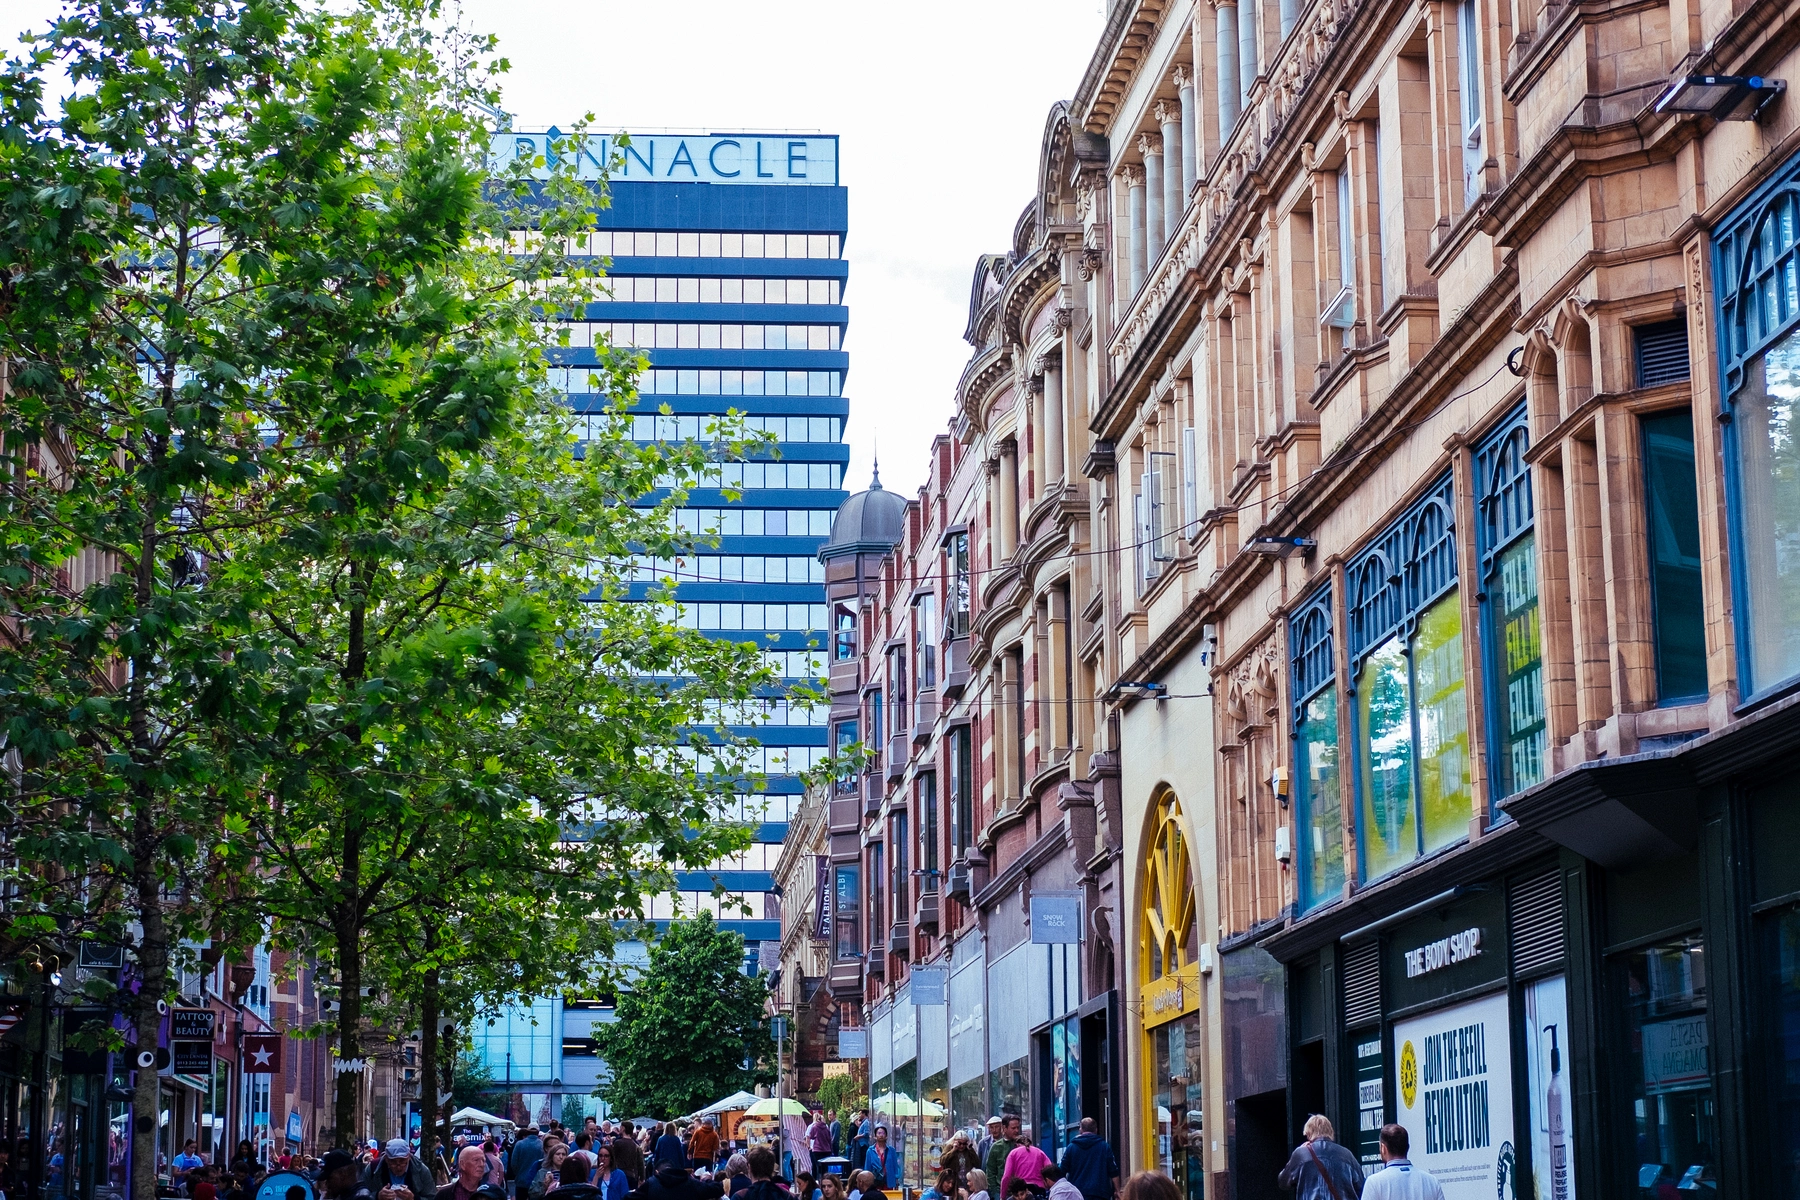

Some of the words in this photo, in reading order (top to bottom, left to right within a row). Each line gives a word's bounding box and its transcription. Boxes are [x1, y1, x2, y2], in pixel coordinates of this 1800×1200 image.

[515, 136, 807, 178] PINNACLE
[1404, 947, 1426, 978] THE
[1425, 937, 1451, 972] BODY
[175, 1012, 214, 1021] TATTOO
[175, 1027, 211, 1036] BEAUTY
[1423, 1033, 1443, 1086] JOIN
[1442, 1029, 1459, 1082] THE
[1458, 1022, 1487, 1079] REFILL
[1424, 1080, 1490, 1155] REVOLUTION
